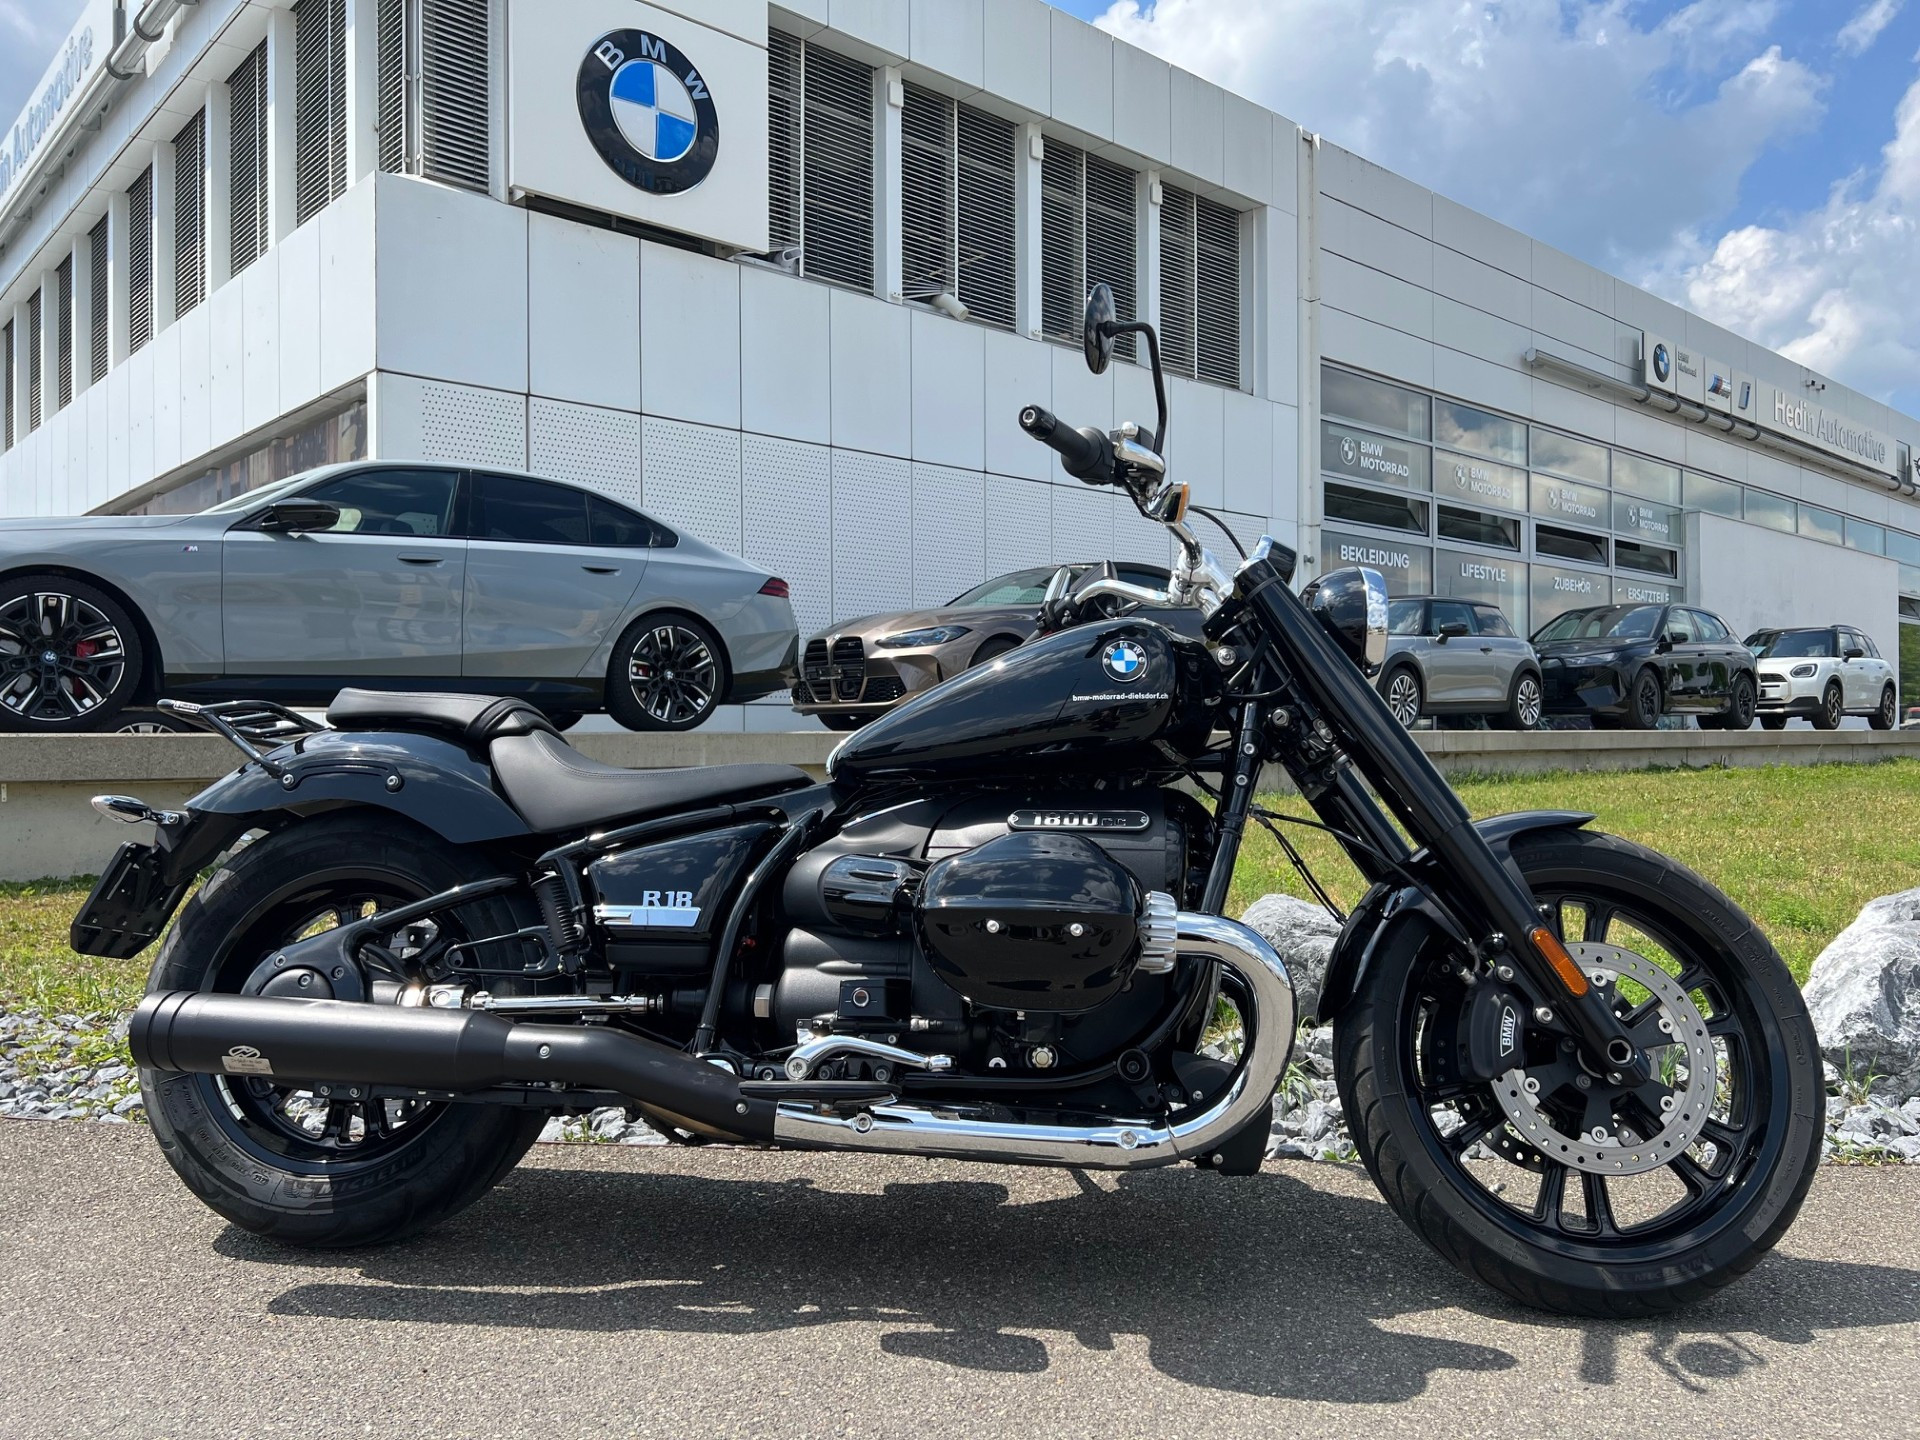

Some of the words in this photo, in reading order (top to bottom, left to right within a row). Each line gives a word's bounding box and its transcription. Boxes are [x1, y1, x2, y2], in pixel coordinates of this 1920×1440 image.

[594, 34, 709, 100] BMW
[1774, 389, 1814, 437] Hedin
[1817, 409, 1885, 464] Automotive
[1360, 441, 1383, 457] BMW
[1360, 456, 1409, 477] MOTORRAD
[1470, 467, 1490, 482] BMW
[1470, 481, 1511, 500] MOTORRAD
[1561, 489, 1578, 502] BMW
[1561, 502, 1596, 518] MOTORRAD
[1639, 507, 1653, 519] BMW
[1639, 520, 1669, 534] MOTORRAD
[1340, 544, 1410, 568] BEKLEIDUNG
[1461, 563, 1506, 582] LIFESTYLE
[1554, 577, 1591, 594] ZUBEHÖR
[1106, 642, 1143, 655] BMW
[1072, 692, 1169, 702] bmw-motorrad-dielsdorf.ch
[1502, 1015, 1514, 1046] BMW
